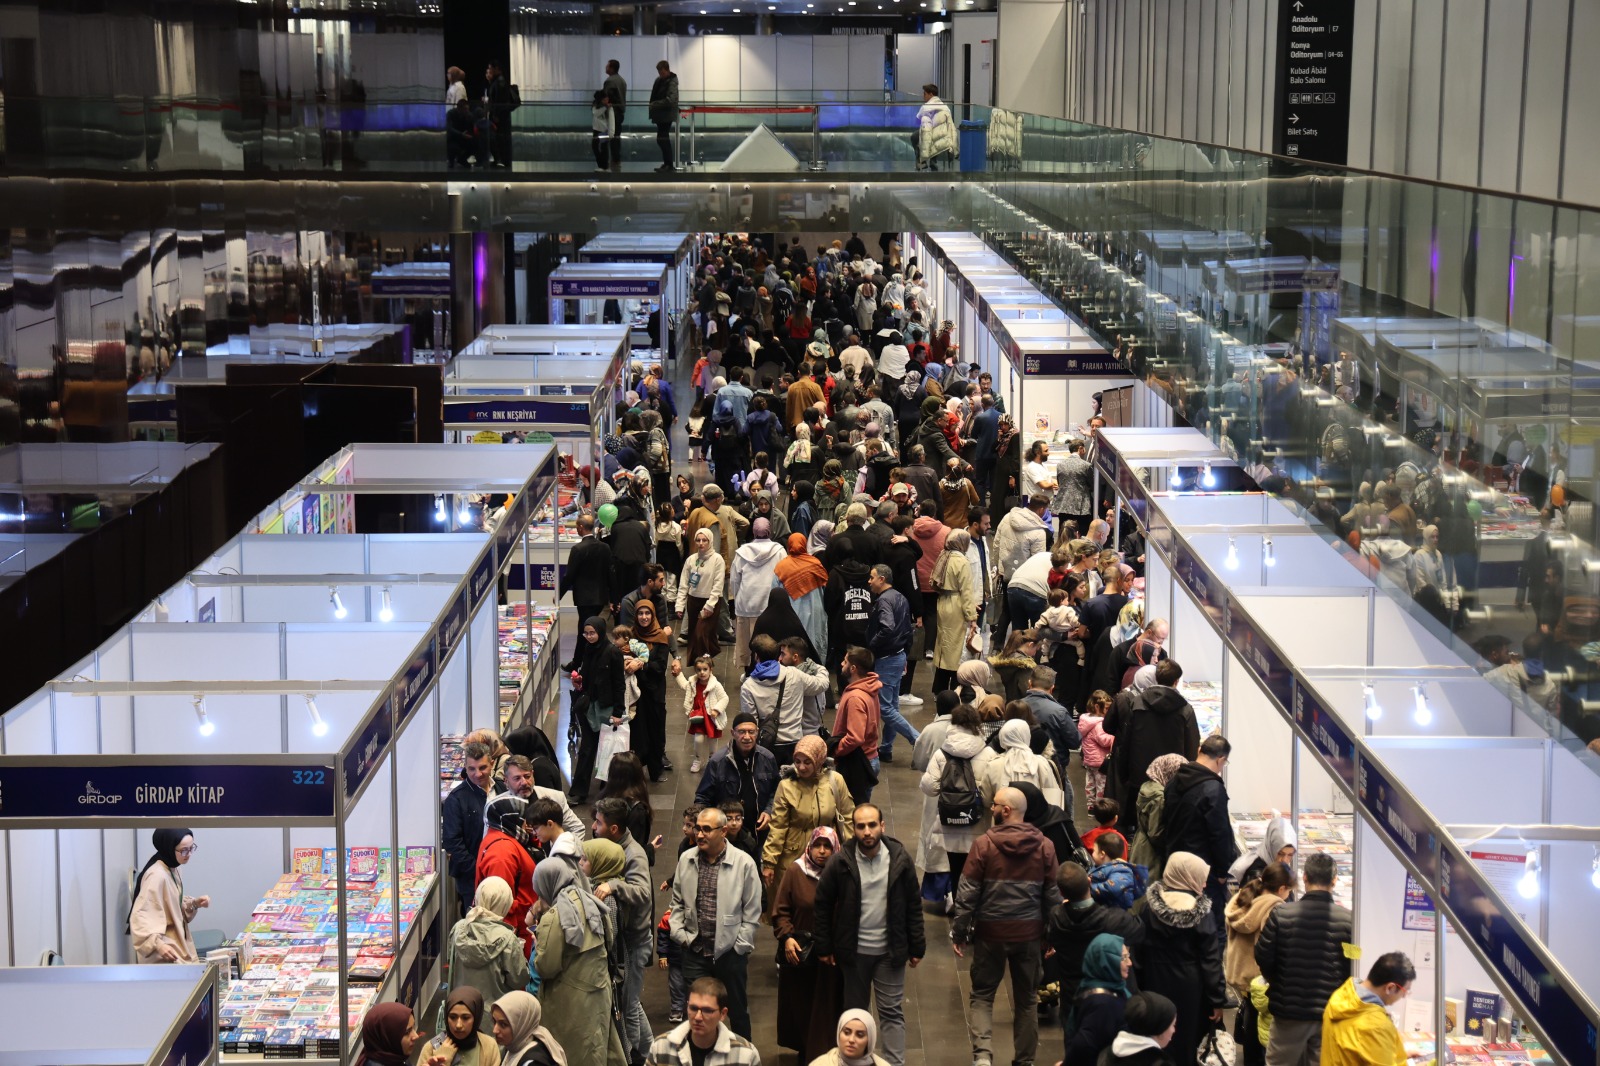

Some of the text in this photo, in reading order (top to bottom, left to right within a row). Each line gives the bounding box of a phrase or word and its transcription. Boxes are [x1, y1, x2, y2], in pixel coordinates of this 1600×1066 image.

[1292, 15, 1318, 23] Anadolu
[1291, 25, 1325, 34] Oditoryum
[1291, 42, 1310, 50] Konya
[1290, 51, 1324, 60] Oditoryum
[1290, 76, 1326, 84] Balo Salonu
[1287, 128, 1318, 137] Bilet Satış
[492, 409, 537, 421] RNK NEŞRİYAT
[292, 770, 325, 785] 322
[135, 782, 225, 804] GİRDAP KİTAP
[296, 850, 318, 858] SUDOKU
[353, 849, 375, 857] SUDOKU
